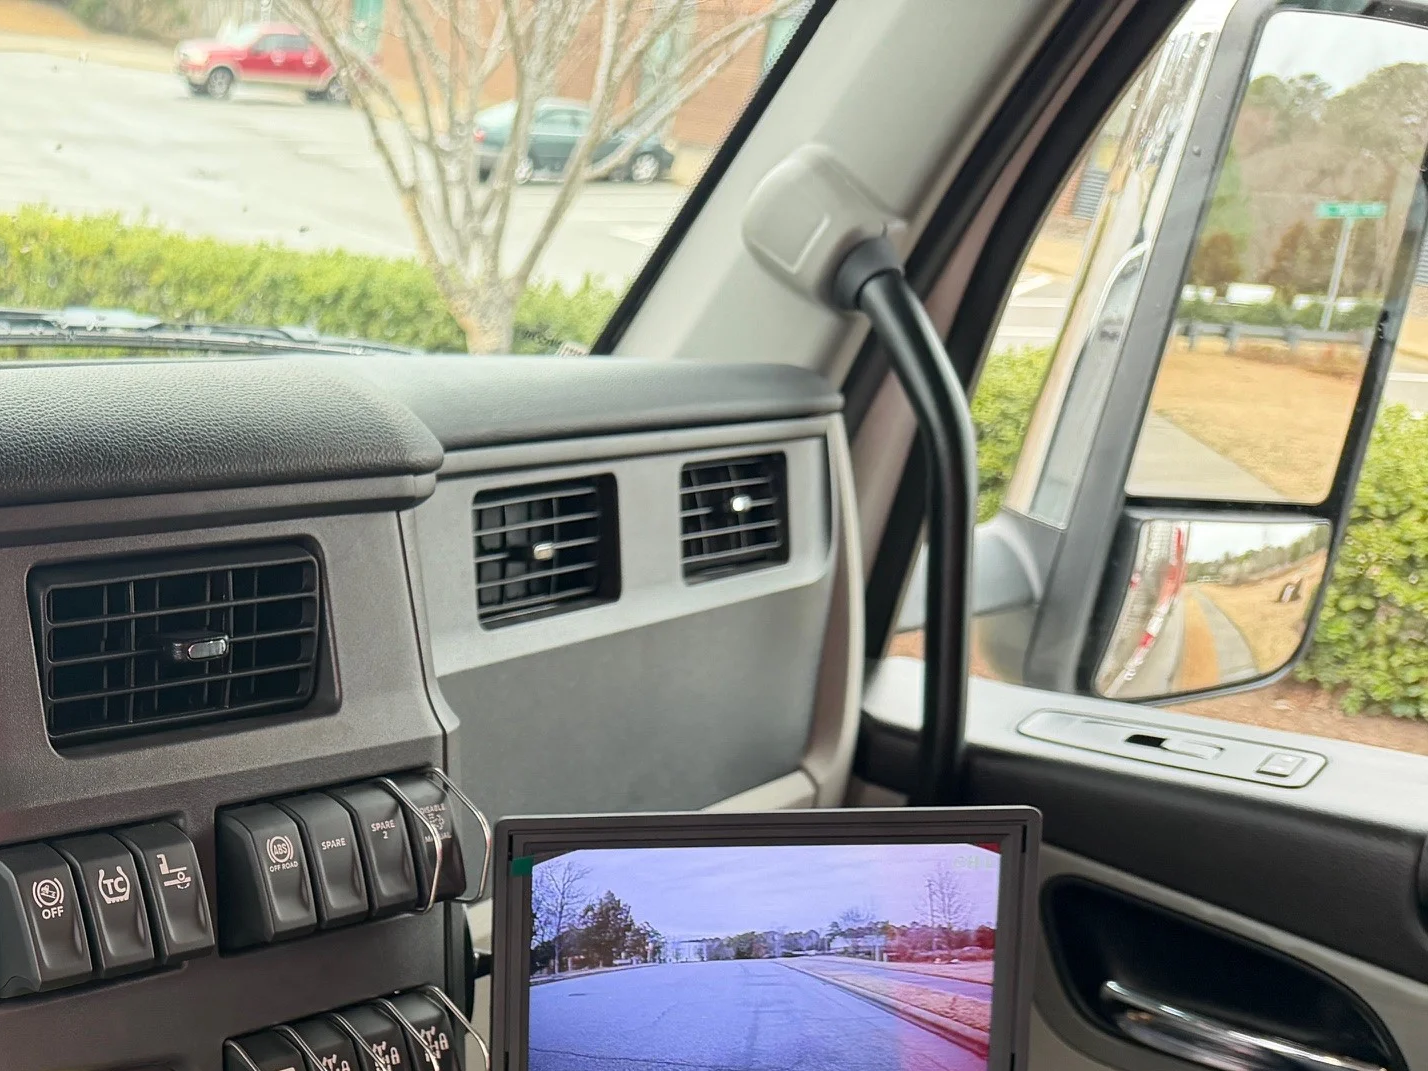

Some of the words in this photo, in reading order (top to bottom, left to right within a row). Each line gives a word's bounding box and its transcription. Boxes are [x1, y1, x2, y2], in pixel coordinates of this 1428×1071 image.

[371, 819, 396, 832] SPARE
[383, 831, 389, 840] 2
[273, 842, 288, 855] ABS
[322, 838, 346, 850] SPARE
[269, 863, 281, 873] OFF
[281, 860, 299, 871] ROAD
[102, 876, 126, 895] TC
[41, 905, 64, 920] OFF
